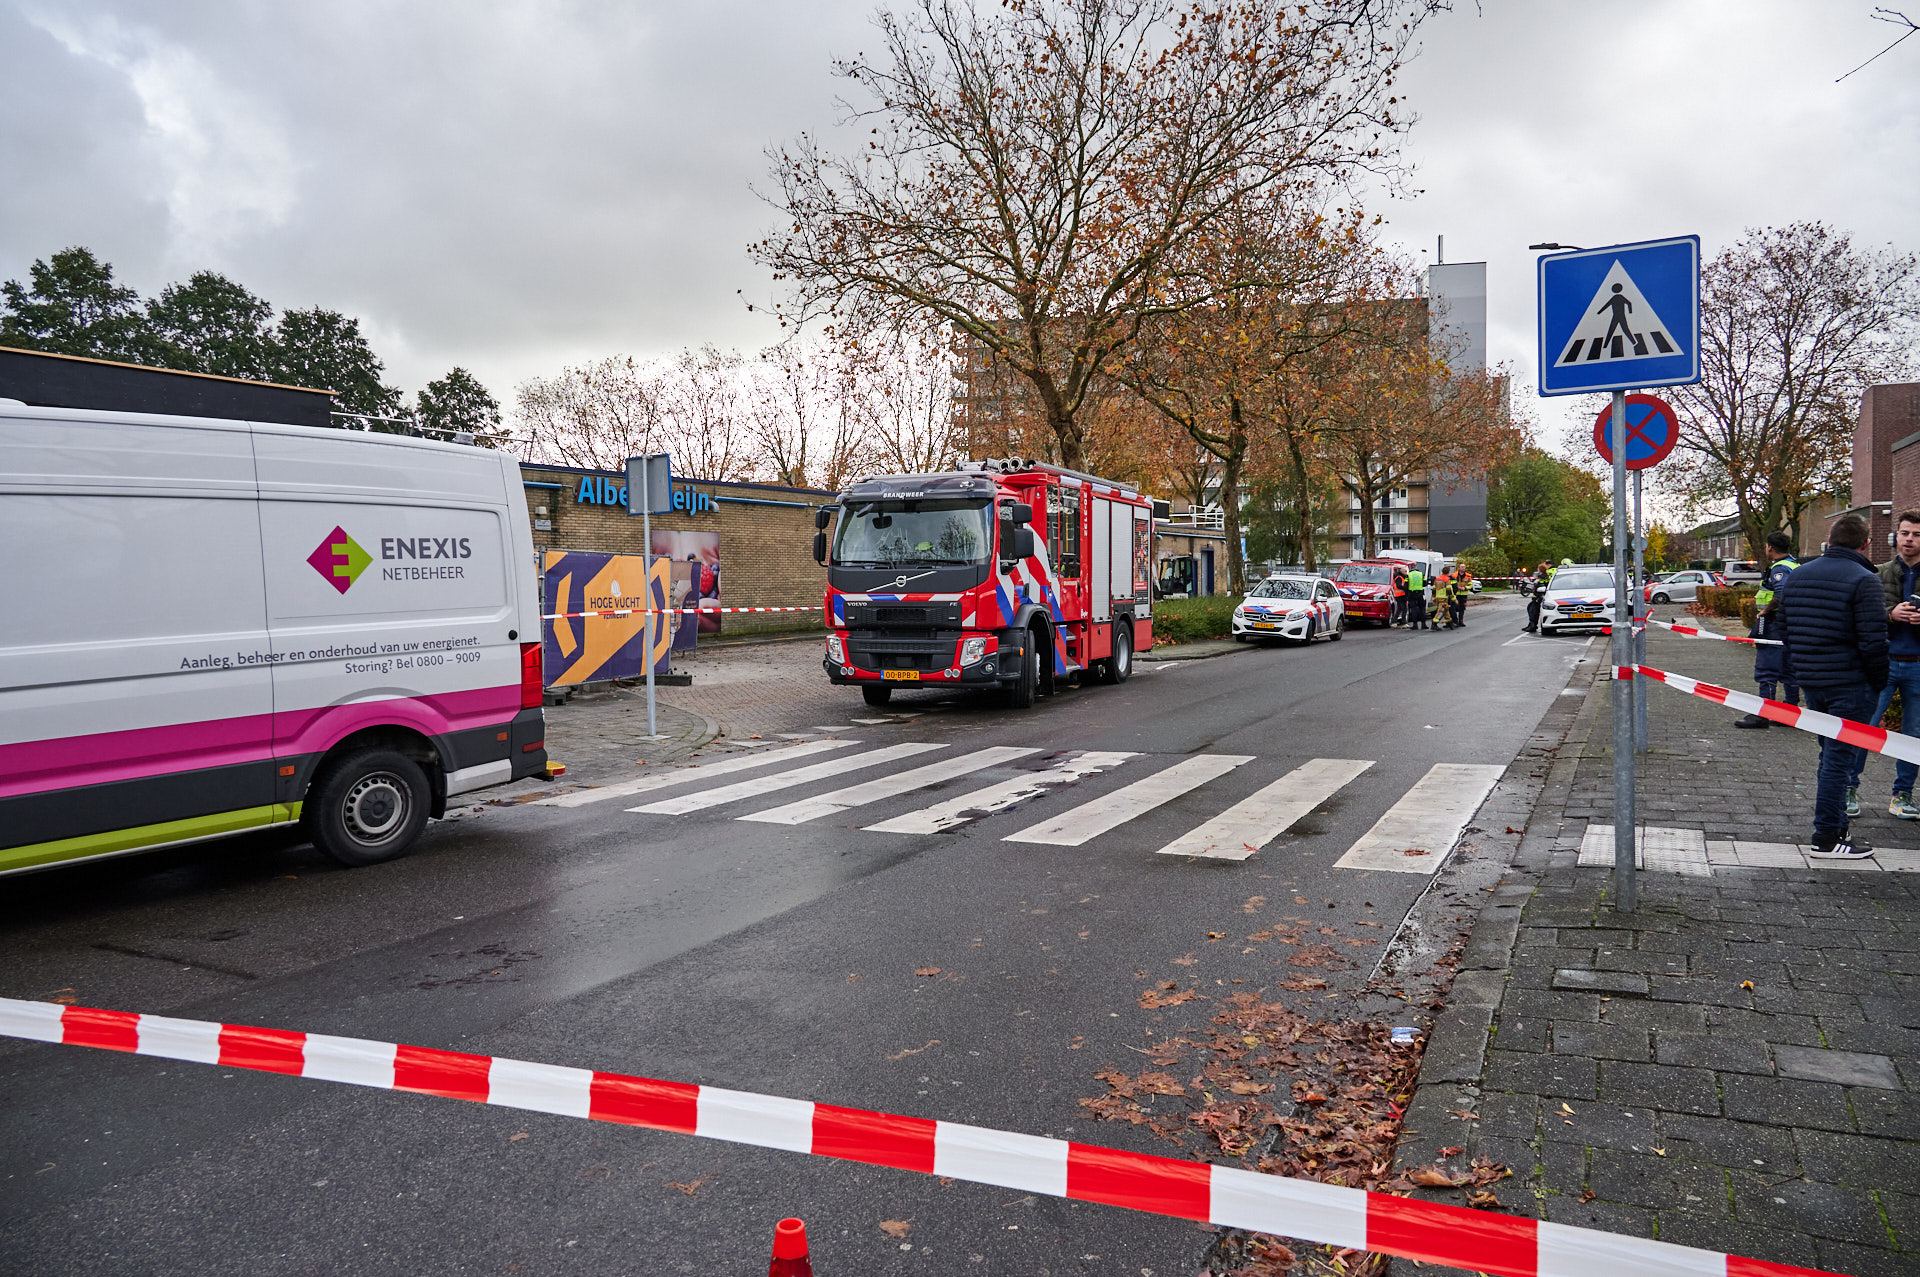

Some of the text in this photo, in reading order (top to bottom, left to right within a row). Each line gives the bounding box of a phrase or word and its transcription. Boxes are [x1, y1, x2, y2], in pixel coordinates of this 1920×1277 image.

[577, 476, 709, 516] Albe eijn
[381, 537, 472, 560] ENEXIS
[383, 566, 464, 581] NETBEHEER
[590, 597, 613, 608] HOGE
[180, 636, 480, 670] Aanleg, beheer en onderhoud van uw energienet.
[345, 660, 393, 674] Storing?
[396, 657, 414, 669] Bel
[416, 655, 444, 667] 0800
[455, 652, 481, 664] 9009
[885, 671, 918, 679] 00-BPB-2
